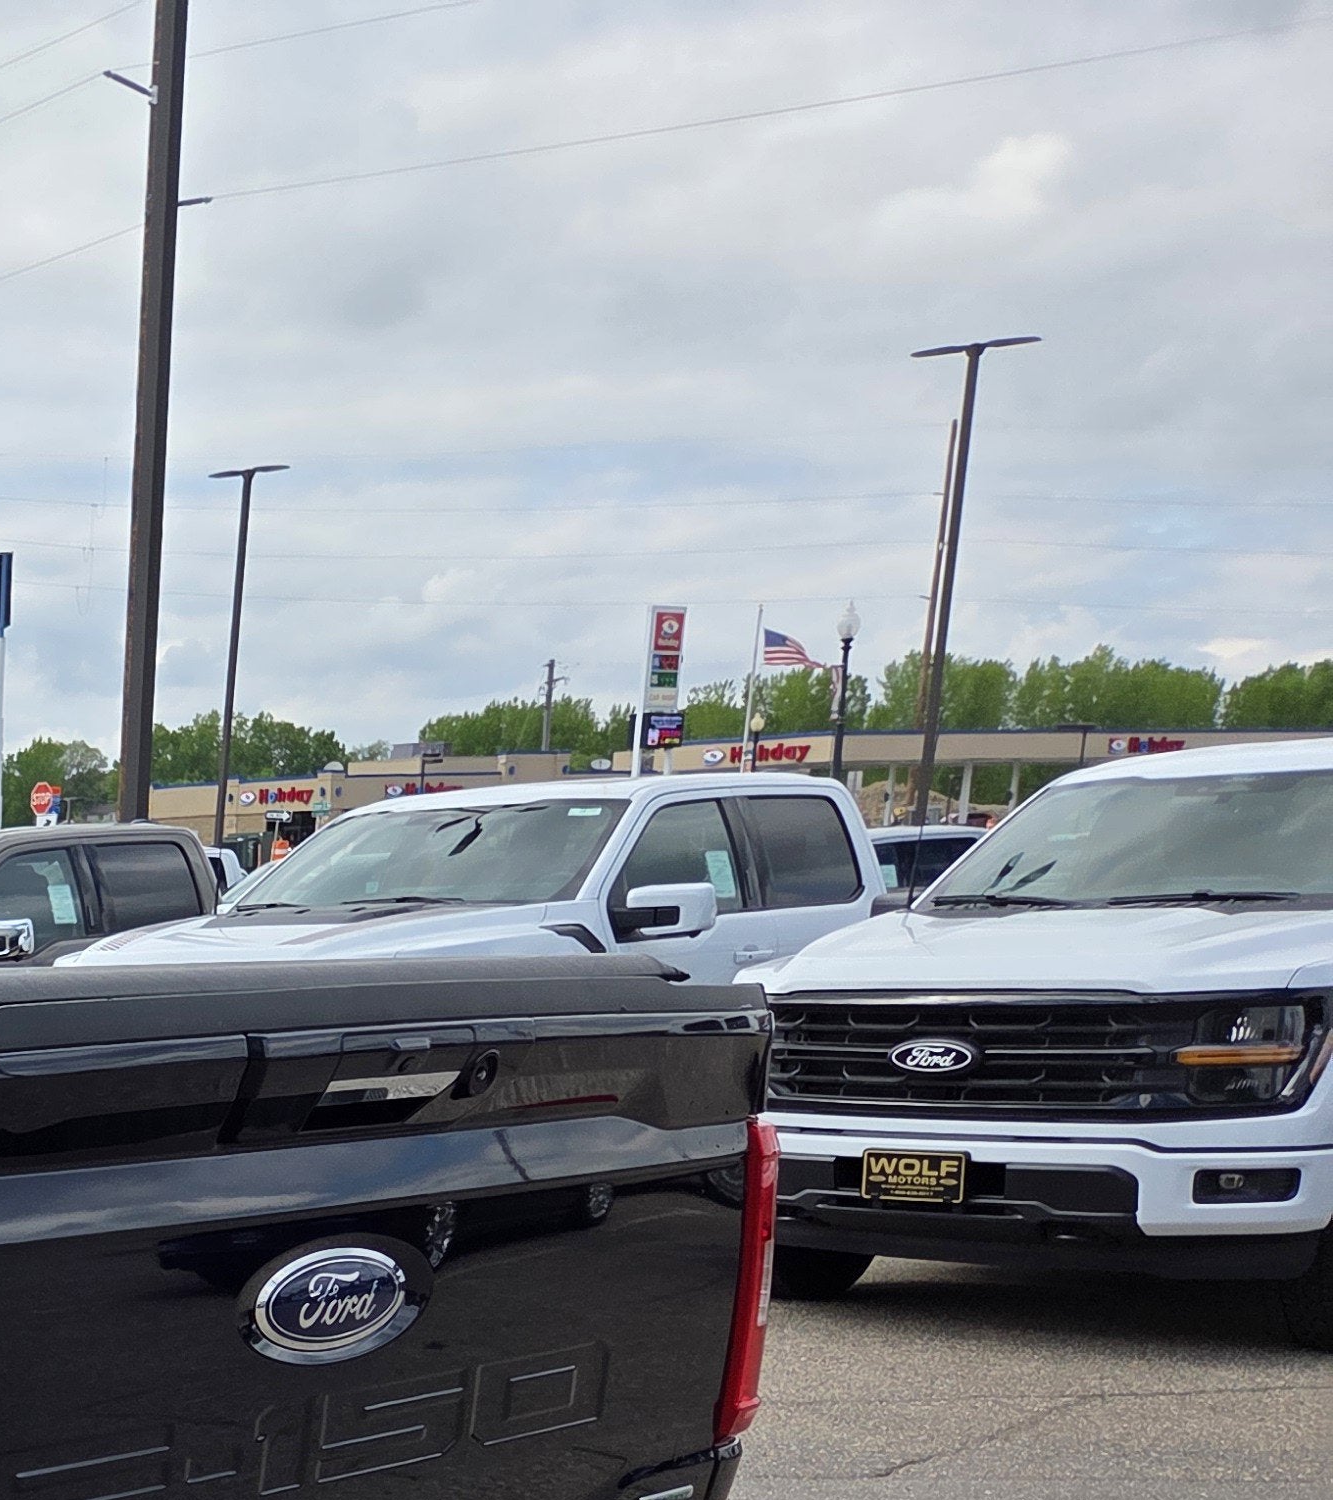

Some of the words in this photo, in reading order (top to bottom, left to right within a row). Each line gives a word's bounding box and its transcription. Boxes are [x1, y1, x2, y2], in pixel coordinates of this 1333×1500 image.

[906, 1045, 957, 1067] Ford
[869, 1157, 959, 1177] WOLF
[887, 1175, 937, 1186] MOTORS
[299, 1270, 379, 1329] Ford
